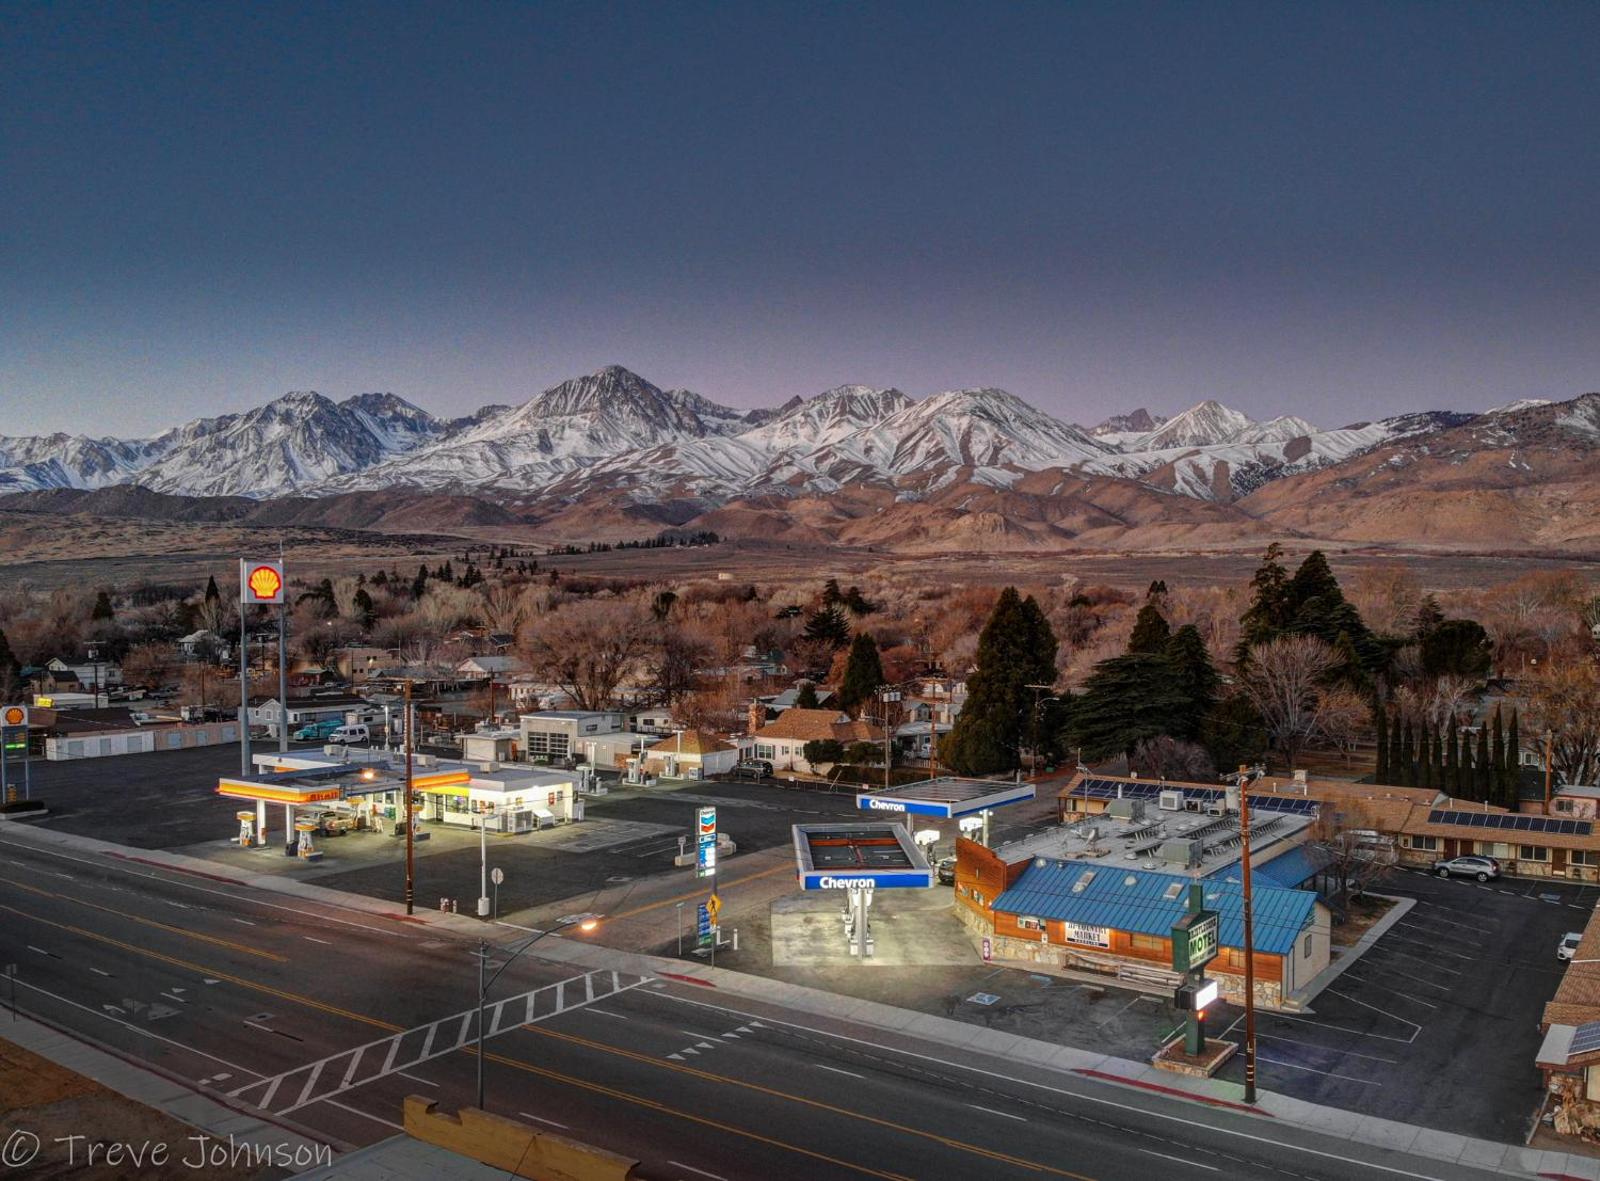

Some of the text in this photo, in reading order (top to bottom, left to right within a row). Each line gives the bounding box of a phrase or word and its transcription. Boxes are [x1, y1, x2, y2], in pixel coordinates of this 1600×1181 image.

[869, 799, 905, 812] Chevron
[819, 876, 875, 889] Chevron
[1073, 930, 1100, 941] MARKET
[1190, 930, 1216, 956] MOTEL
